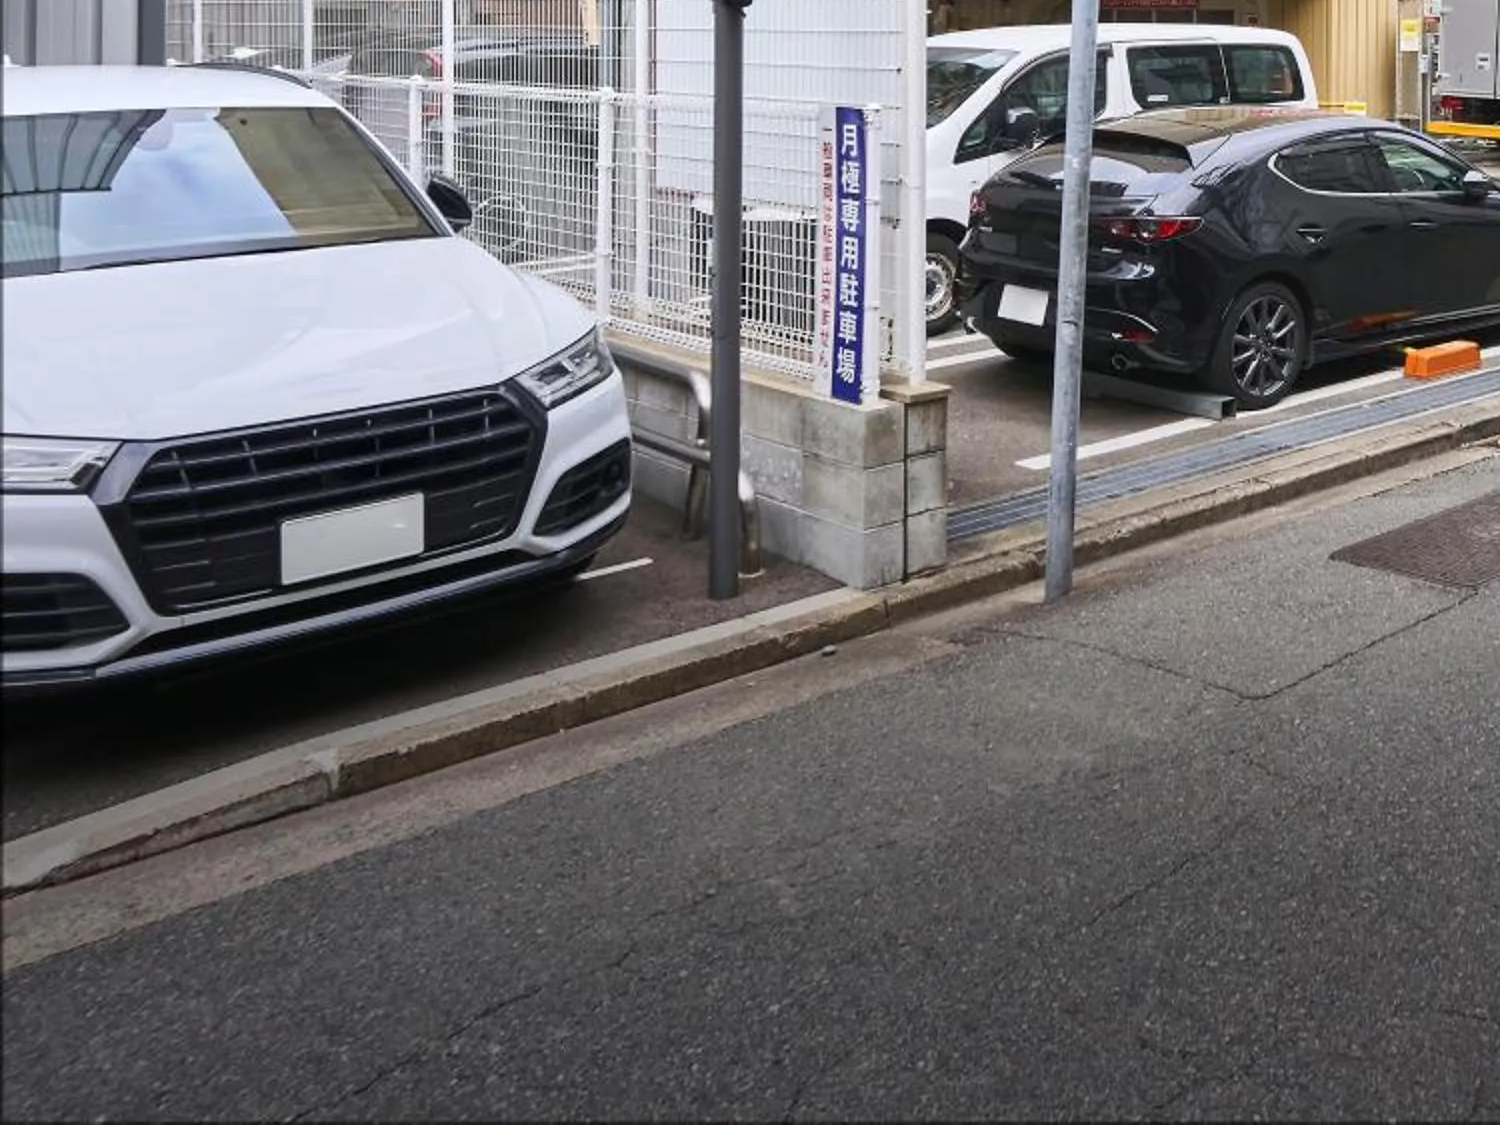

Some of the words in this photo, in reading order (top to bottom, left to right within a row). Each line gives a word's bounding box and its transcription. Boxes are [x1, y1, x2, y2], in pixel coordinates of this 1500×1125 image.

[836, 122, 861, 384] 月極専用駐車場
